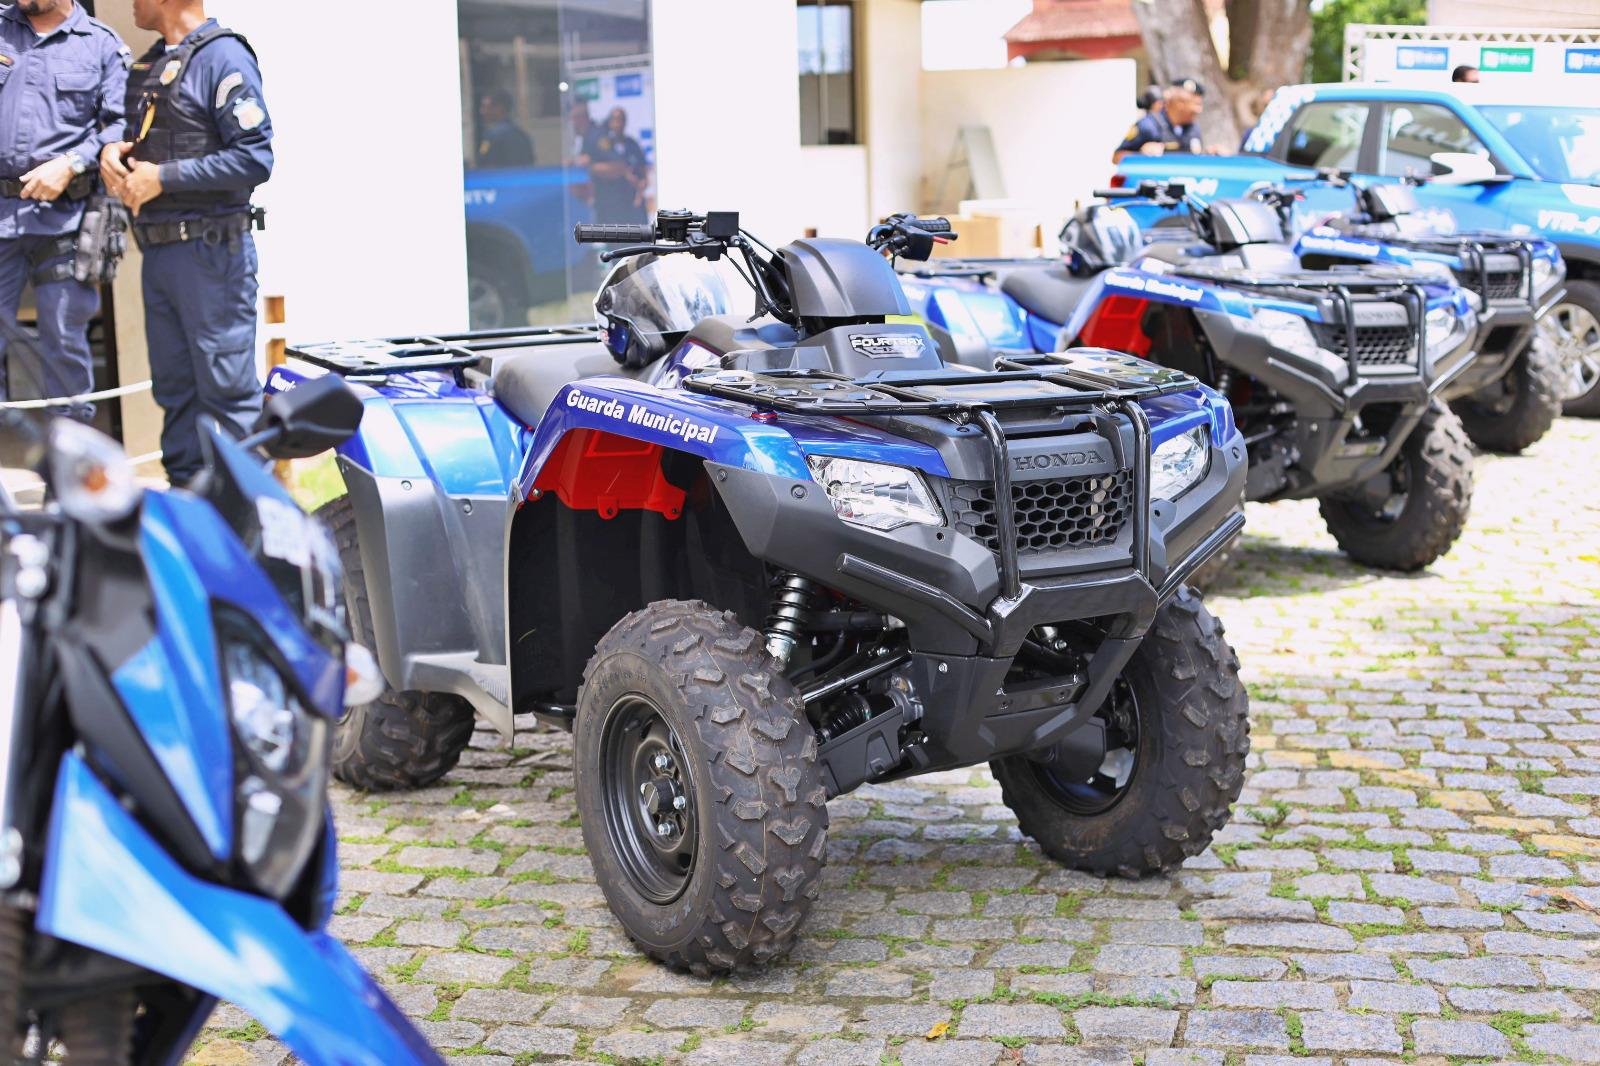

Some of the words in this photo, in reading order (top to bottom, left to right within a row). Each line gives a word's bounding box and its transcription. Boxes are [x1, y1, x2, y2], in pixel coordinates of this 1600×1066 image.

[566, 389, 625, 420] Guarda
[627, 404, 719, 444] Municipal
[1013, 450, 1106, 471] HONDA
